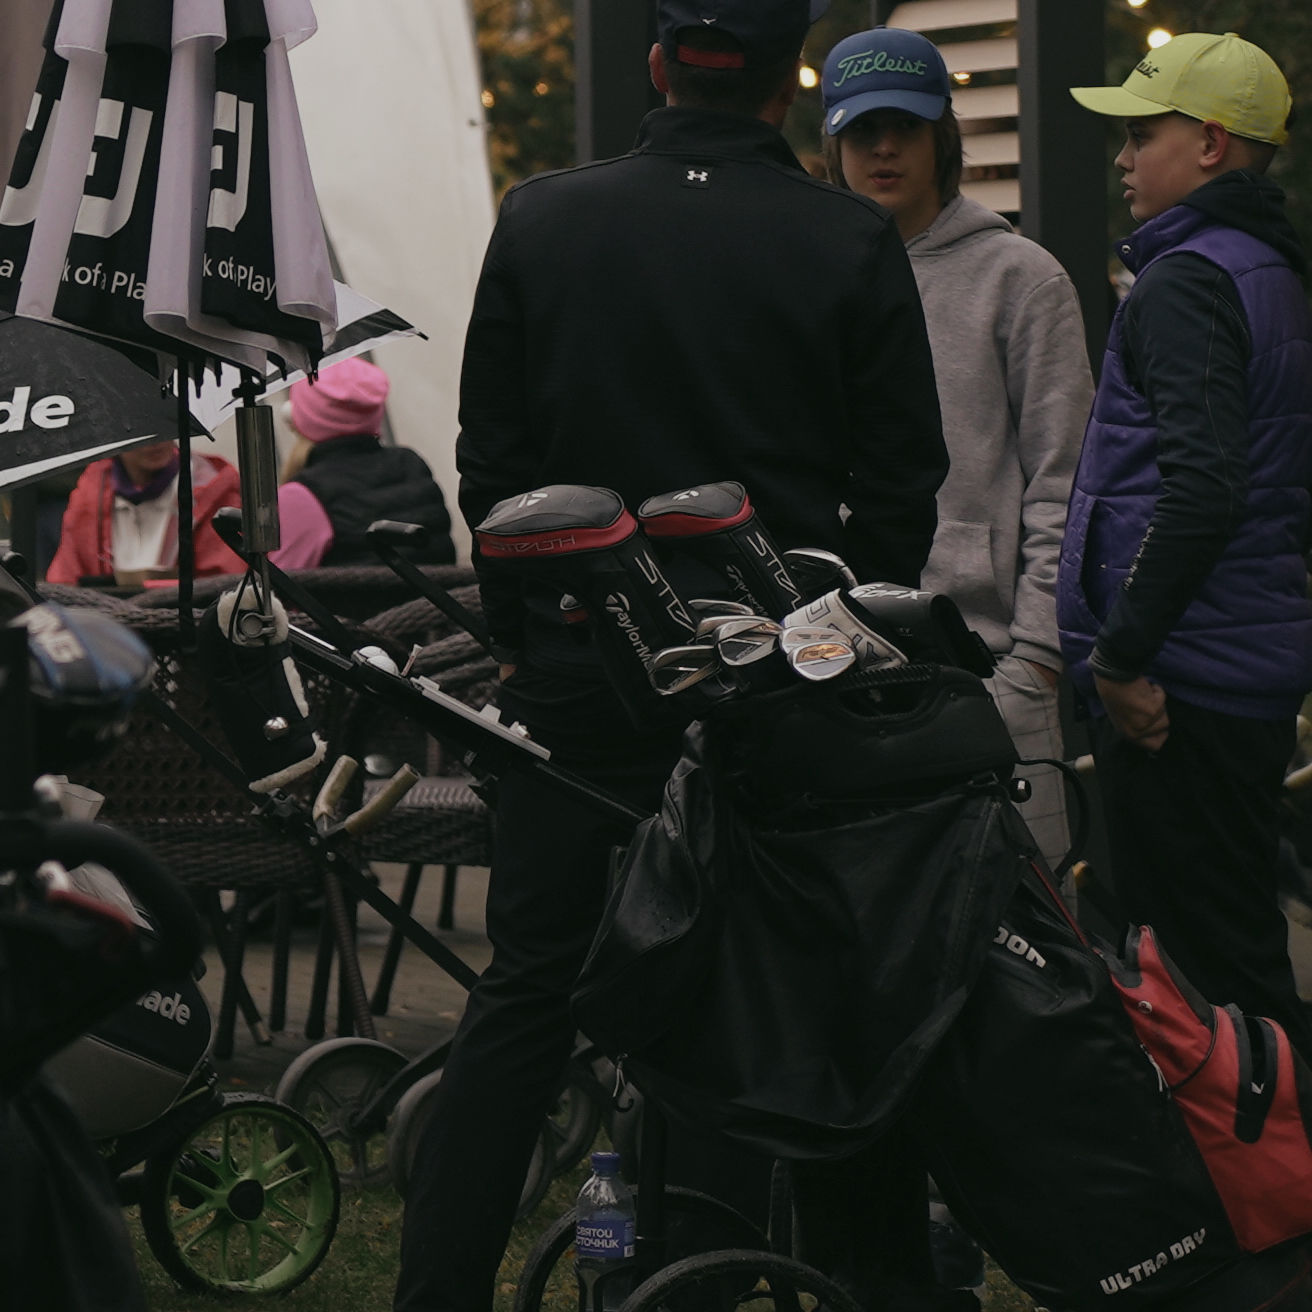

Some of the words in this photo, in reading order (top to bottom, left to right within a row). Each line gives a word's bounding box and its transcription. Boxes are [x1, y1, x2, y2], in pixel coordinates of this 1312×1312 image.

[833, 49, 927, 87] Titleist
[74, 262, 103, 286] of
[110, 271, 146, 300] Pla
[217, 256, 234, 281] of
[237, 264, 277, 301] Play
[605, 591, 653, 670] TaylorM
[575, 1235, 620, 1248] СТОЧНИК
[1099, 1251, 1168, 1295] ULTRA
[1169, 1227, 1206, 1261] DRY
